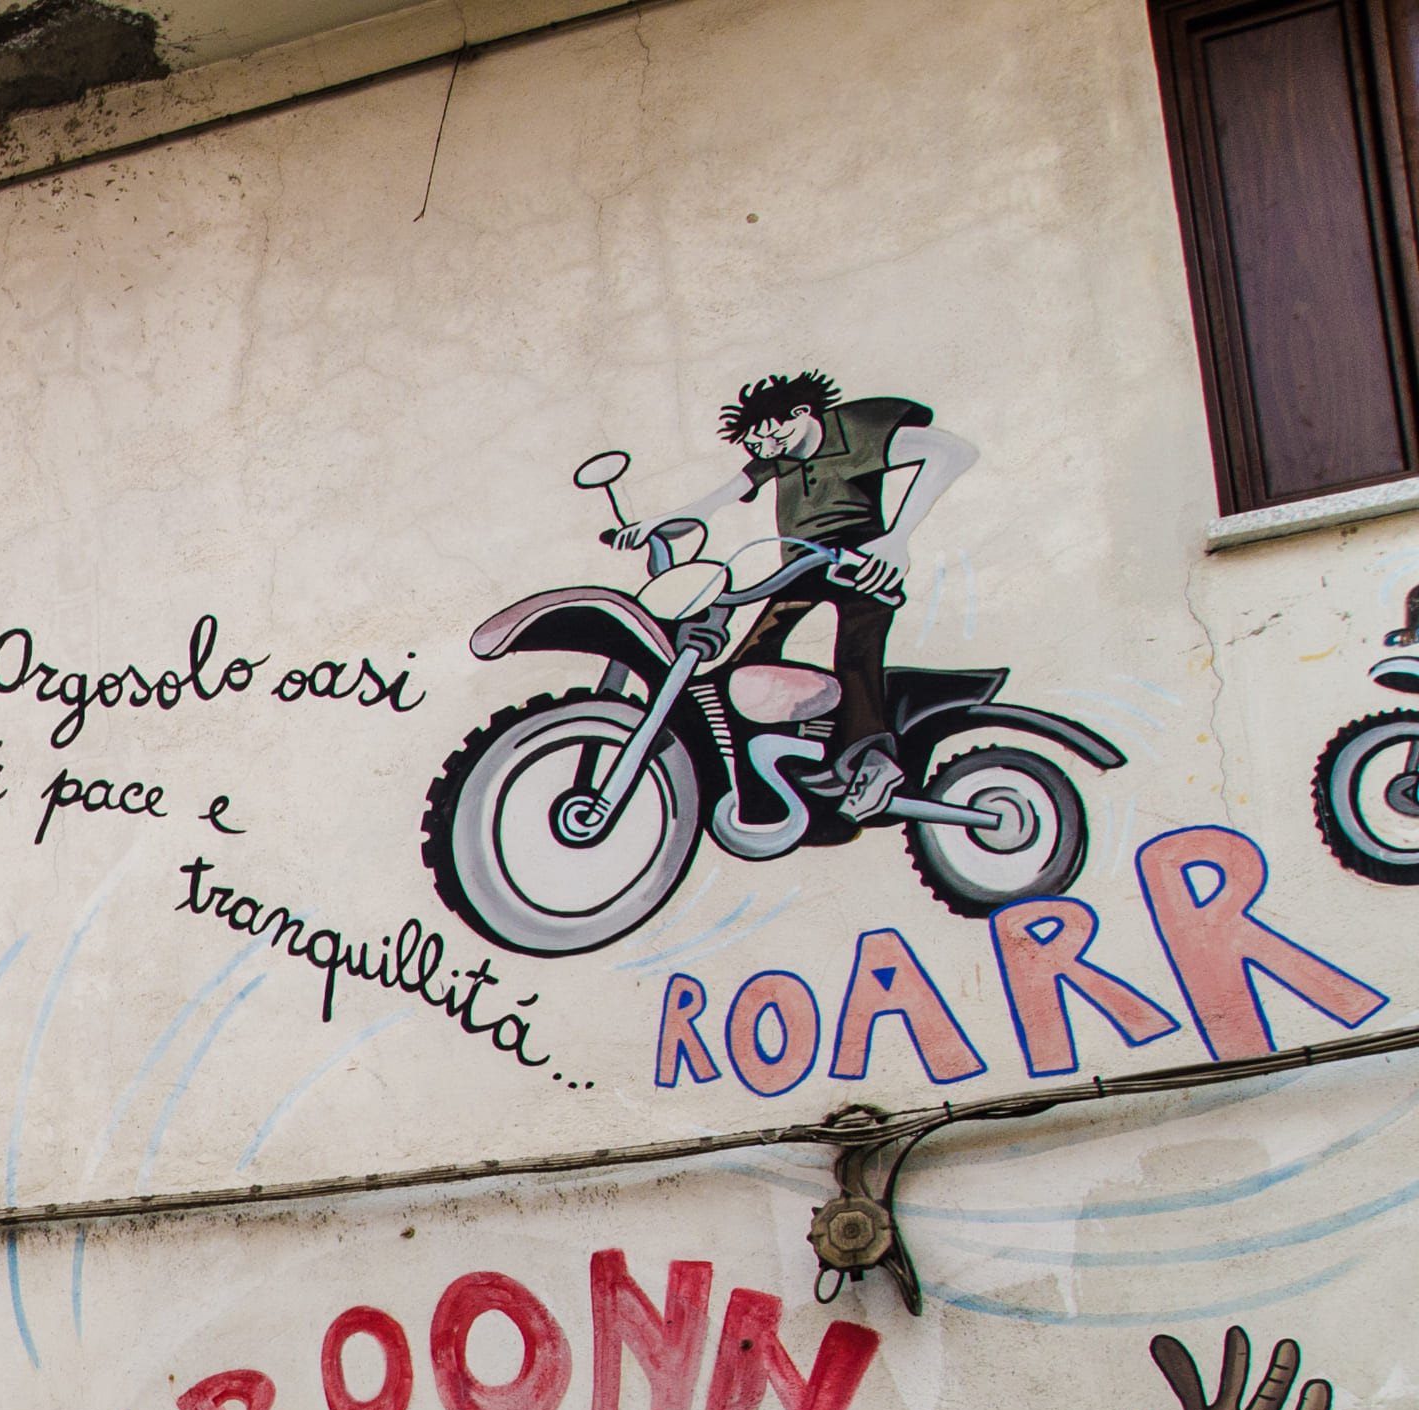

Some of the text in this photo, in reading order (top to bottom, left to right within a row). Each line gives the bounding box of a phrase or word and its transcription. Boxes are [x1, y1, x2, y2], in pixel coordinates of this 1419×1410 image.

[271, 651, 426, 712] oasi
[34, 767, 169, 845] pace
[199, 795, 247, 833] e
[653, 824, 1390, 1099] ROARR
